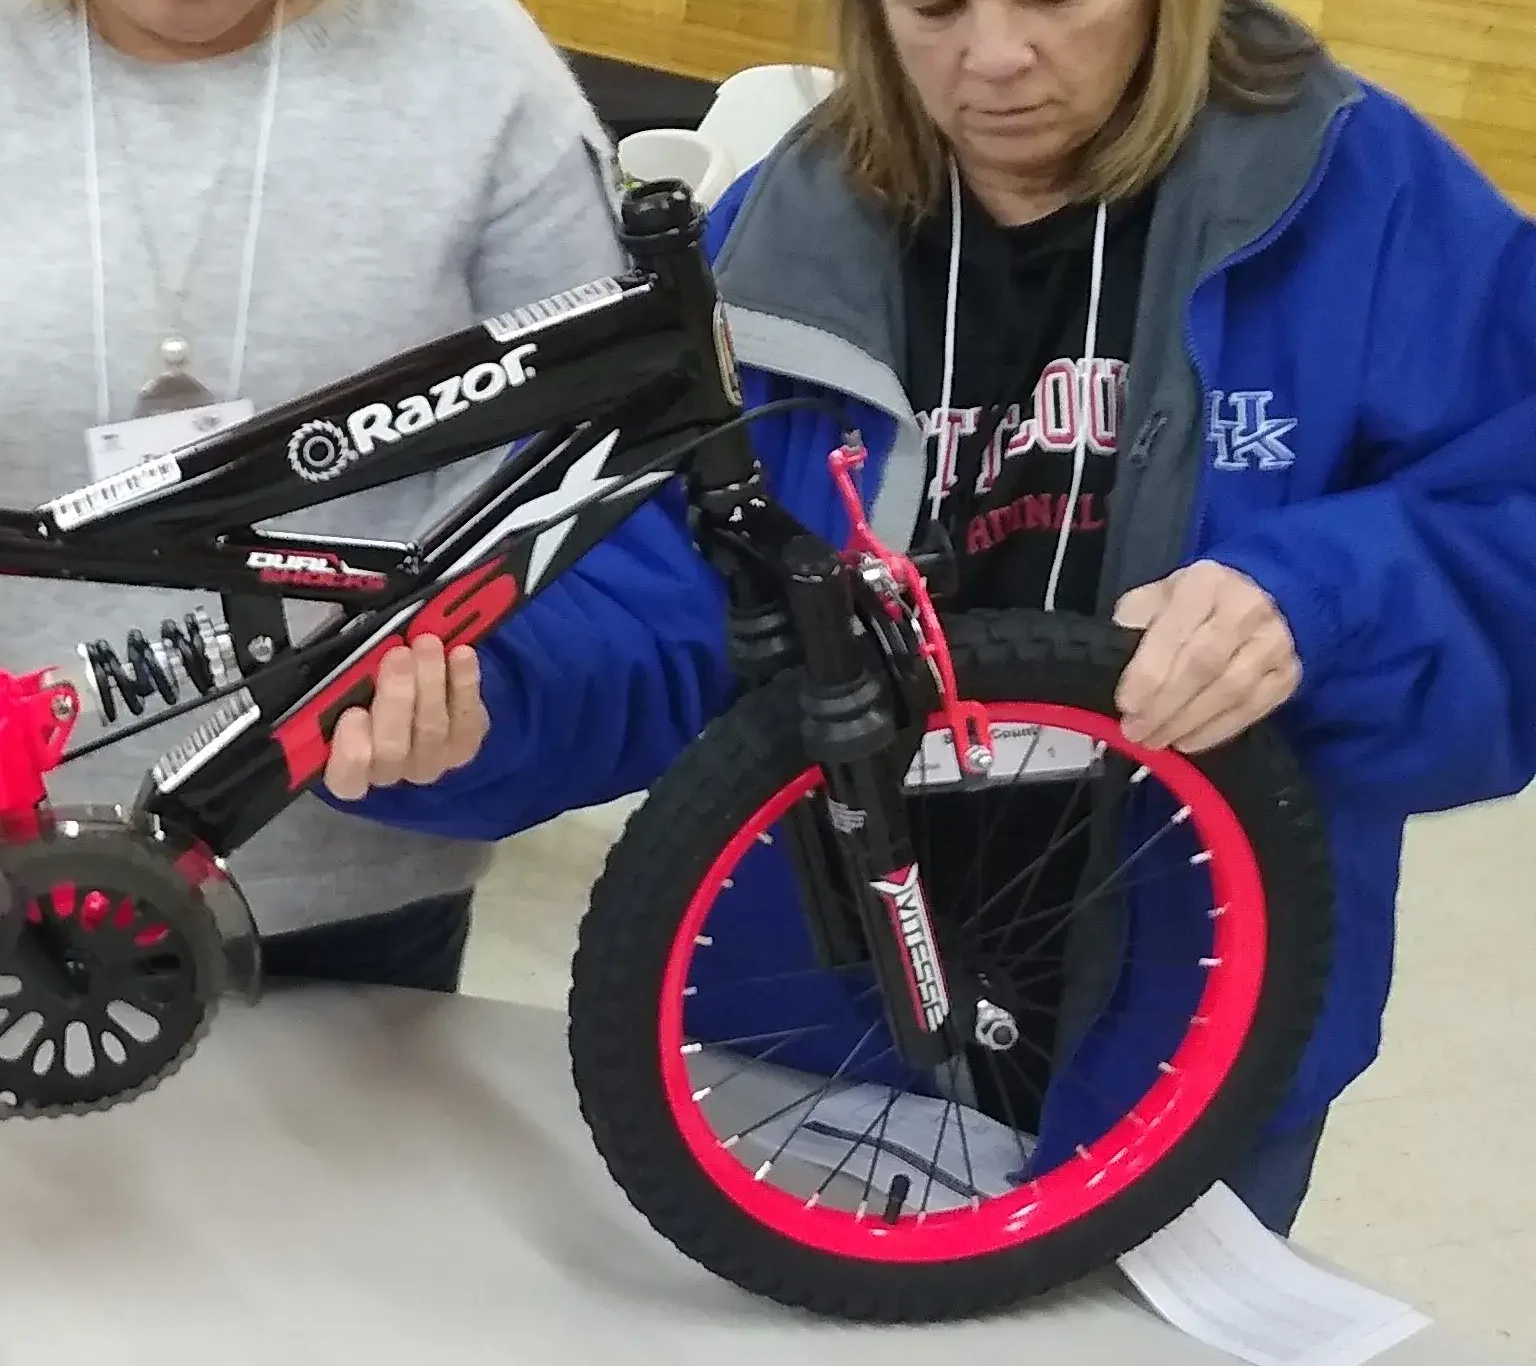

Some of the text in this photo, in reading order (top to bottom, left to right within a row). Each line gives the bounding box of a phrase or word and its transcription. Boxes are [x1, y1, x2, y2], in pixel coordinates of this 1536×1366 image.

[346, 342, 539, 455] Razor
[1205, 389, 1298, 471] UK
[894, 886, 948, 1032] VITESSE
